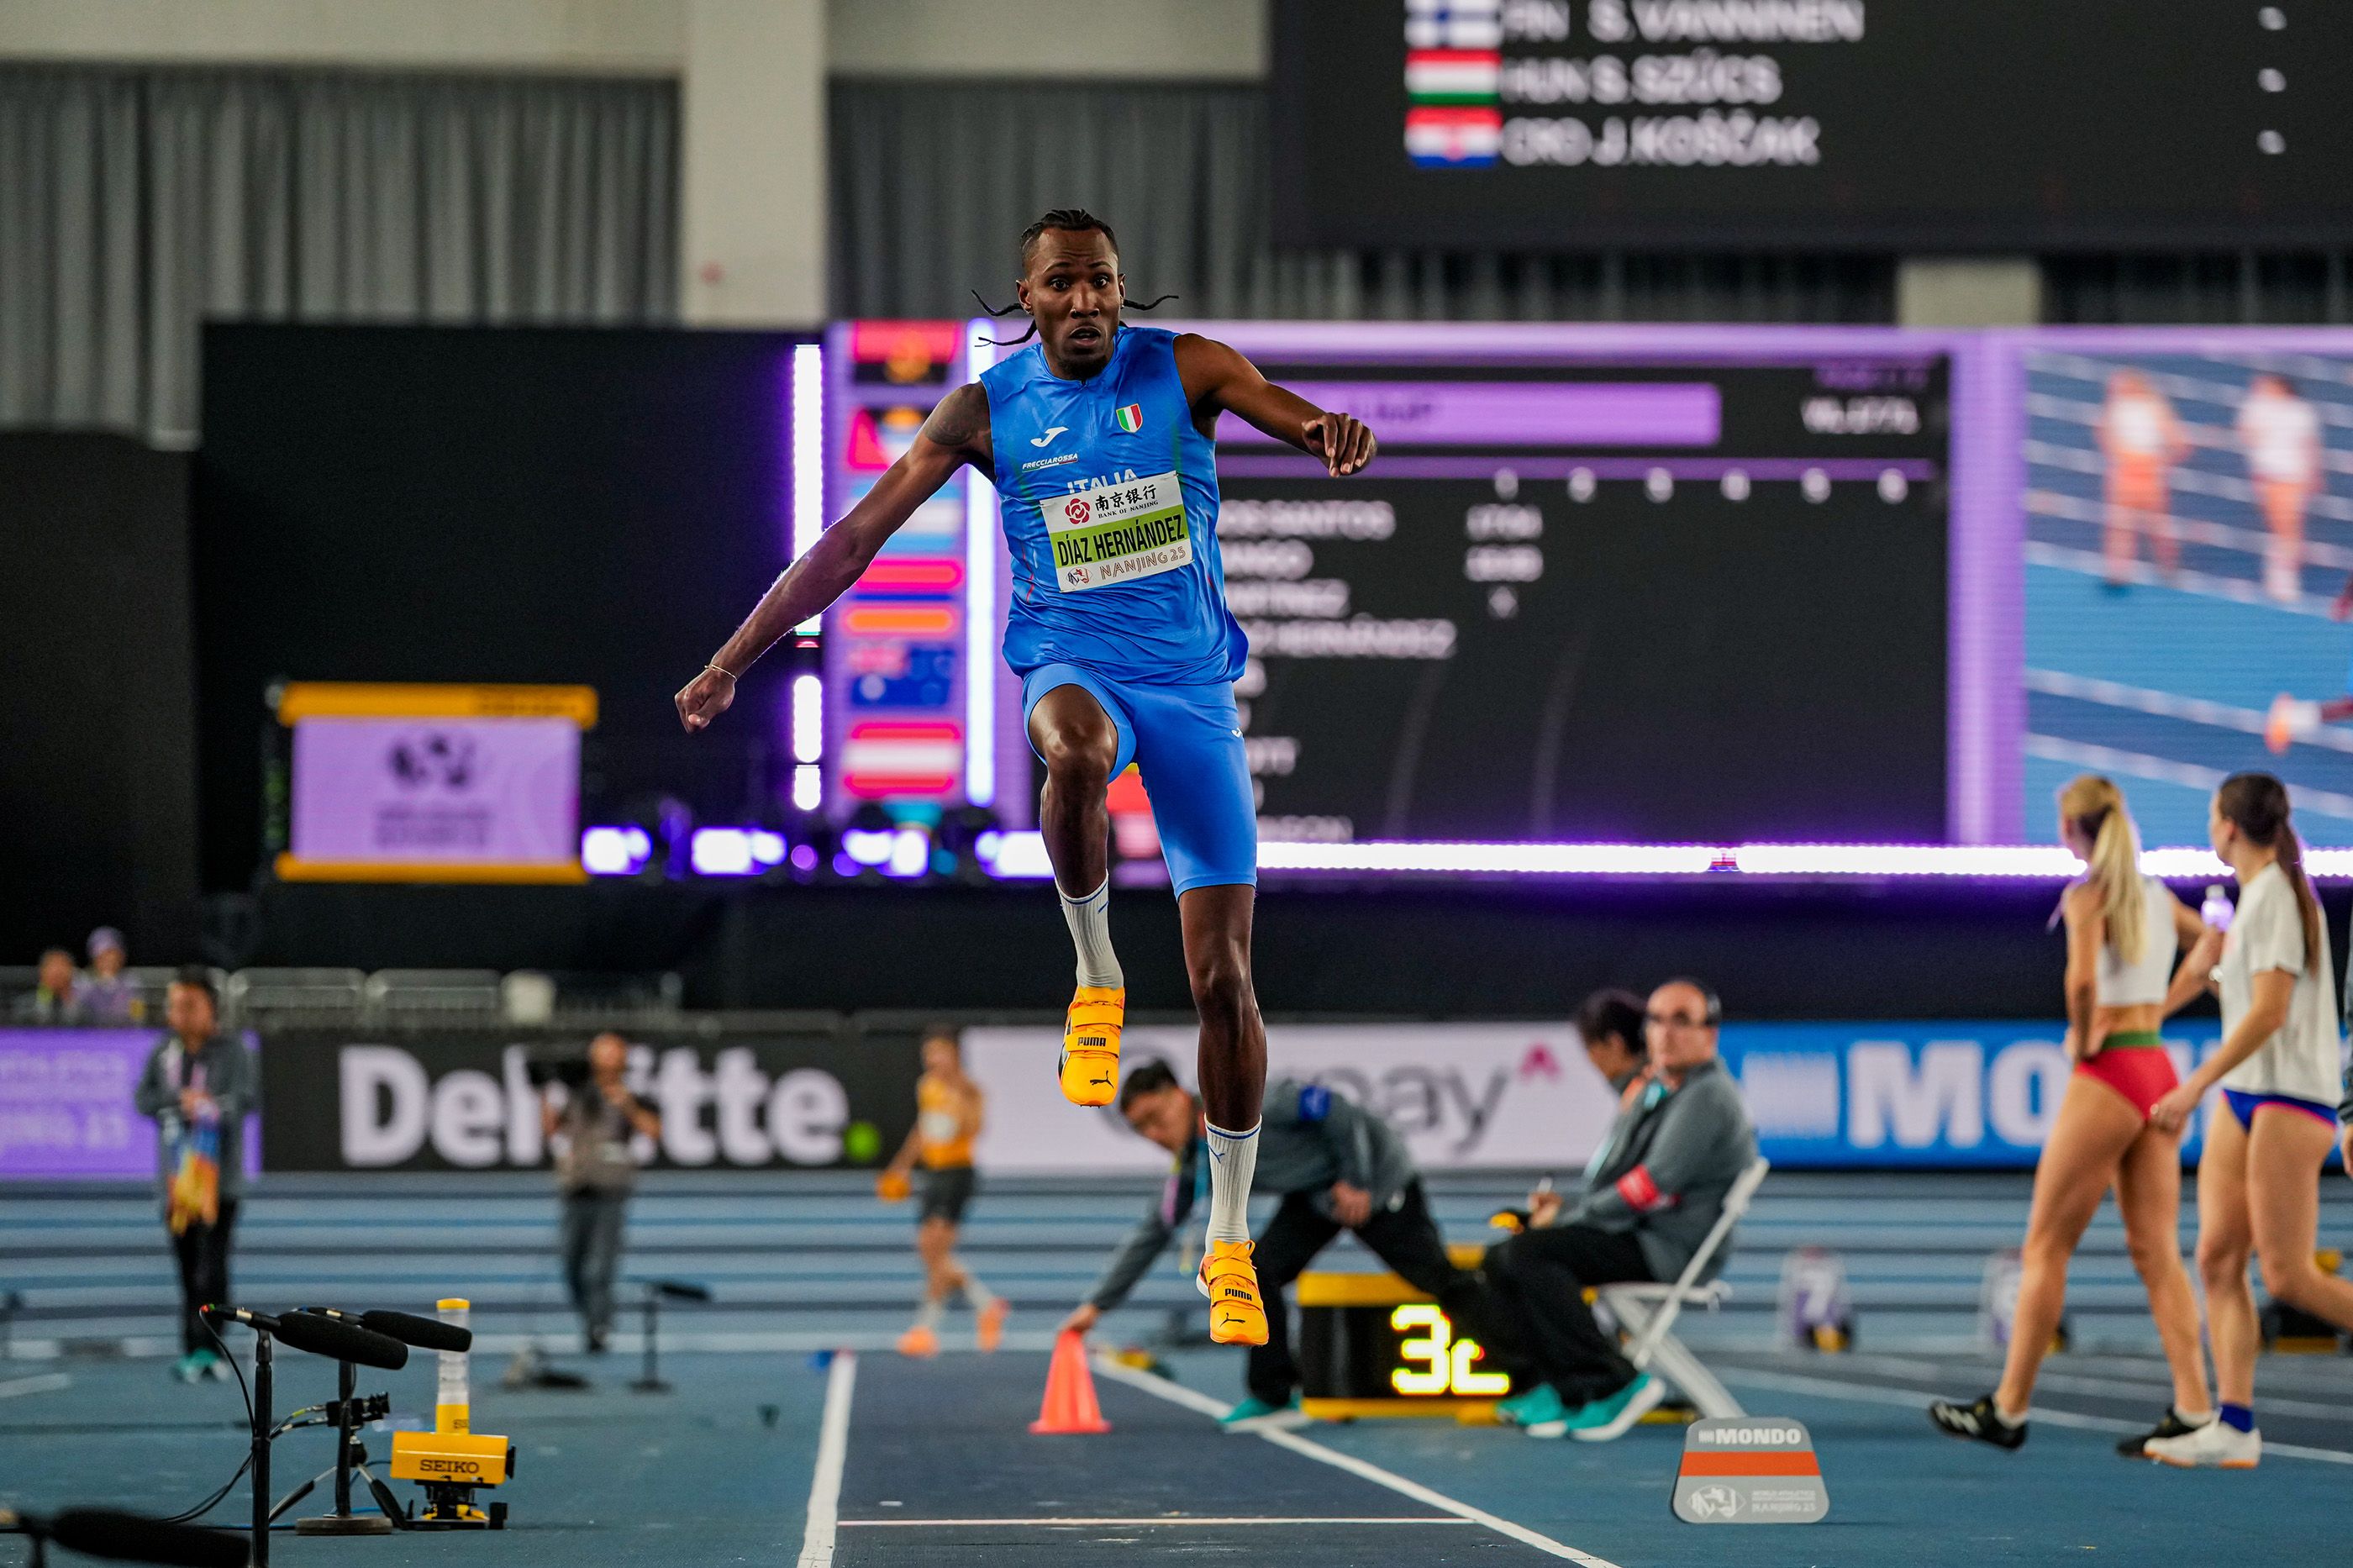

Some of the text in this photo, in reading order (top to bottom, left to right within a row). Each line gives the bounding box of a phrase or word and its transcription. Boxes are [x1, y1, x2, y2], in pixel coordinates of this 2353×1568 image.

[1022, 453, 1078, 470] FRECCIAROSSA
[1095, 484, 1156, 511] 南京银行
[1098, 511, 1118, 519] BANK
[1130, 500, 1159, 512] NANJING
[1057, 534, 1092, 566] DÍAZ
[1093, 514, 1185, 560] HERNÁNDEZ
[1100, 546, 1187, 580] NANJING 25
[1077, 1036, 1107, 1047] PUMA
[1224, 1288, 1253, 1301] PUMA
[1715, 1428, 1802, 1445] MONDO
[419, 1459, 480, 1474] SEIKO
